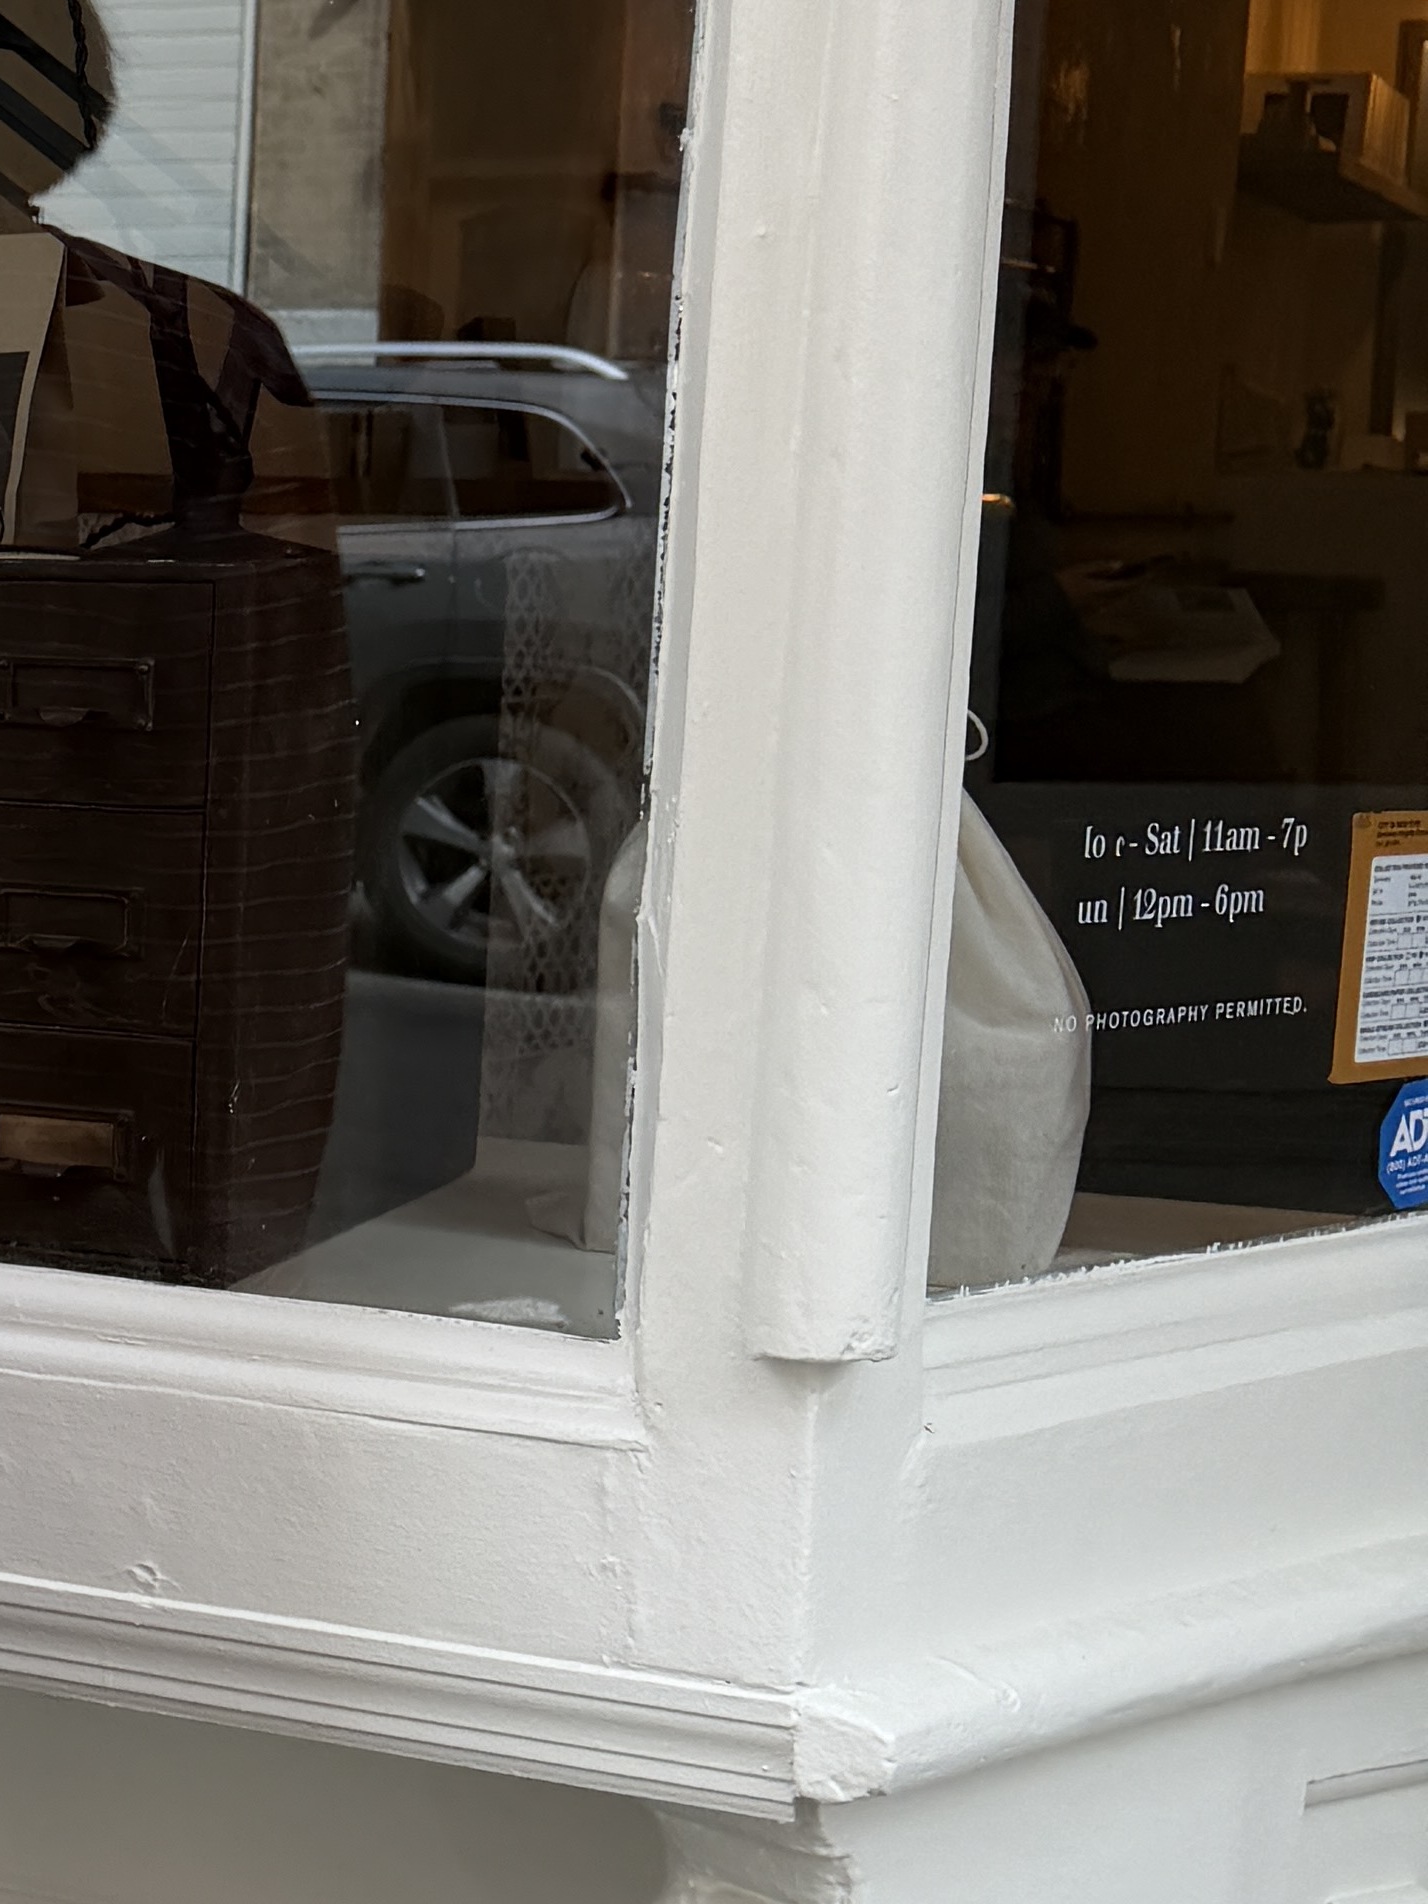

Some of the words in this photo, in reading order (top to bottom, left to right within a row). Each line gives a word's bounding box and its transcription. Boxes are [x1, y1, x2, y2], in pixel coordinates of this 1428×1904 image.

[1145, 822, 1181, 856] Sat
[1202, 819, 1261, 853] 11am
[1133, 888, 1194, 928] 12pm
[1214, 883, 1265, 924] 6pm
[1053, 1015, 1077, 1033] NO
[1084, 1004, 1209, 1033] PHOTOGRAPHY
[1215, 996, 1308, 1020] PERMITTED.
